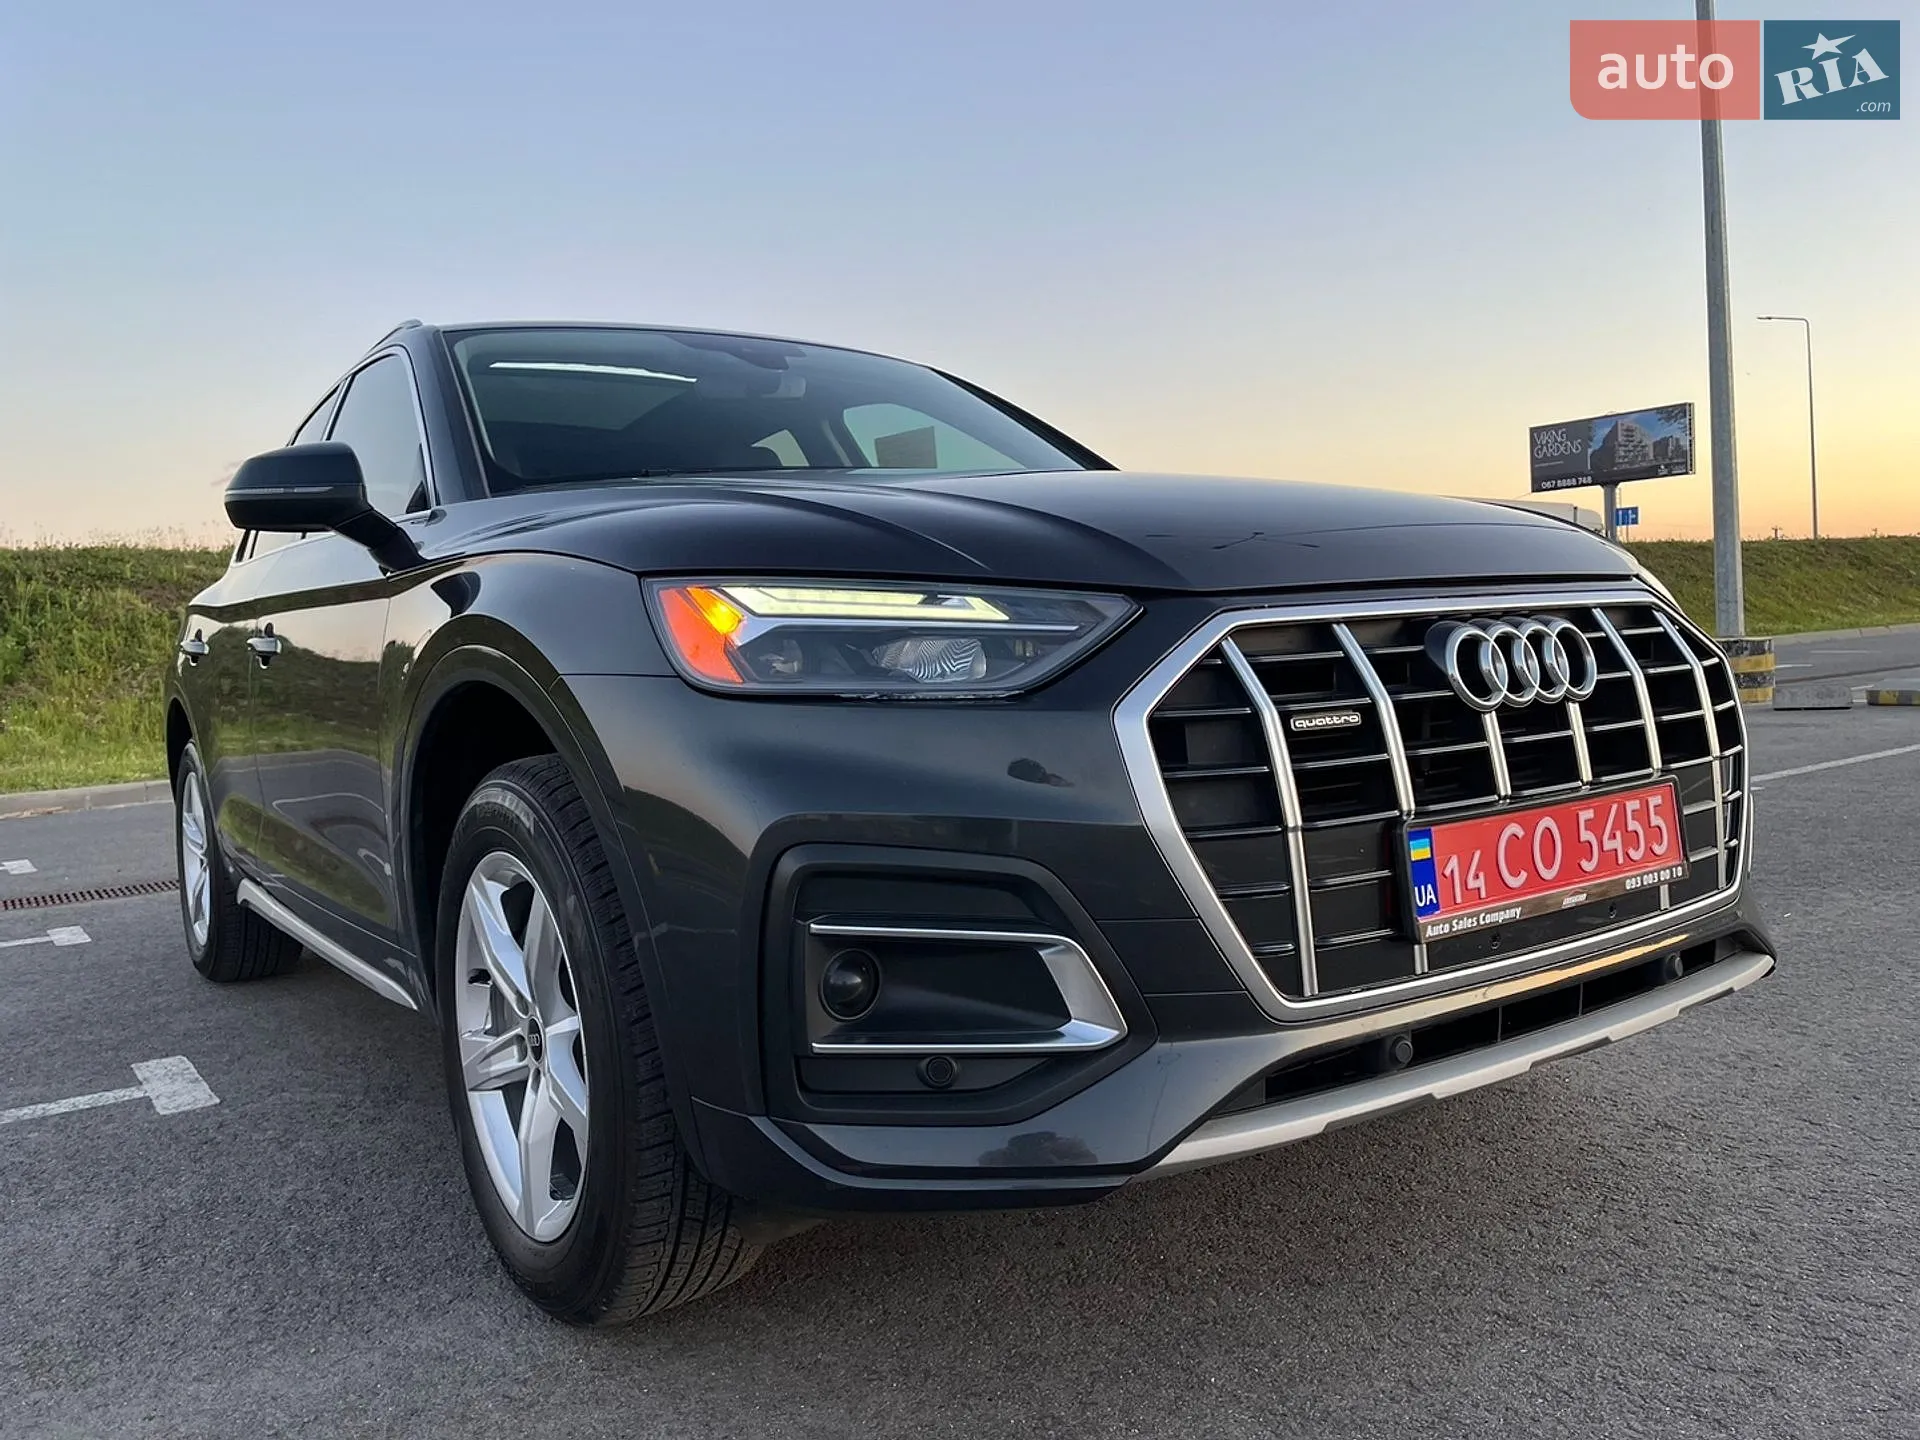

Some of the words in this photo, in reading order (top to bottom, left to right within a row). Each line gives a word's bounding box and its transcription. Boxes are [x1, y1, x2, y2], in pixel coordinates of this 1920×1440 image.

[1534, 429, 1566, 444] VIKING
[1534, 440, 1581, 458] GARDENS
[1294, 714, 1359, 728] quattro
[1443, 849, 1486, 904] 14
[1498, 816, 1562, 889] CO
[1577, 796, 1668, 872] 5455
[1625, 876, 1641, 890] 093
[1414, 883, 1437, 907] UA
[1425, 924, 1450, 938] Auto
[1452, 916, 1478, 932] Sales
[1479, 906, 1522, 926] Company
